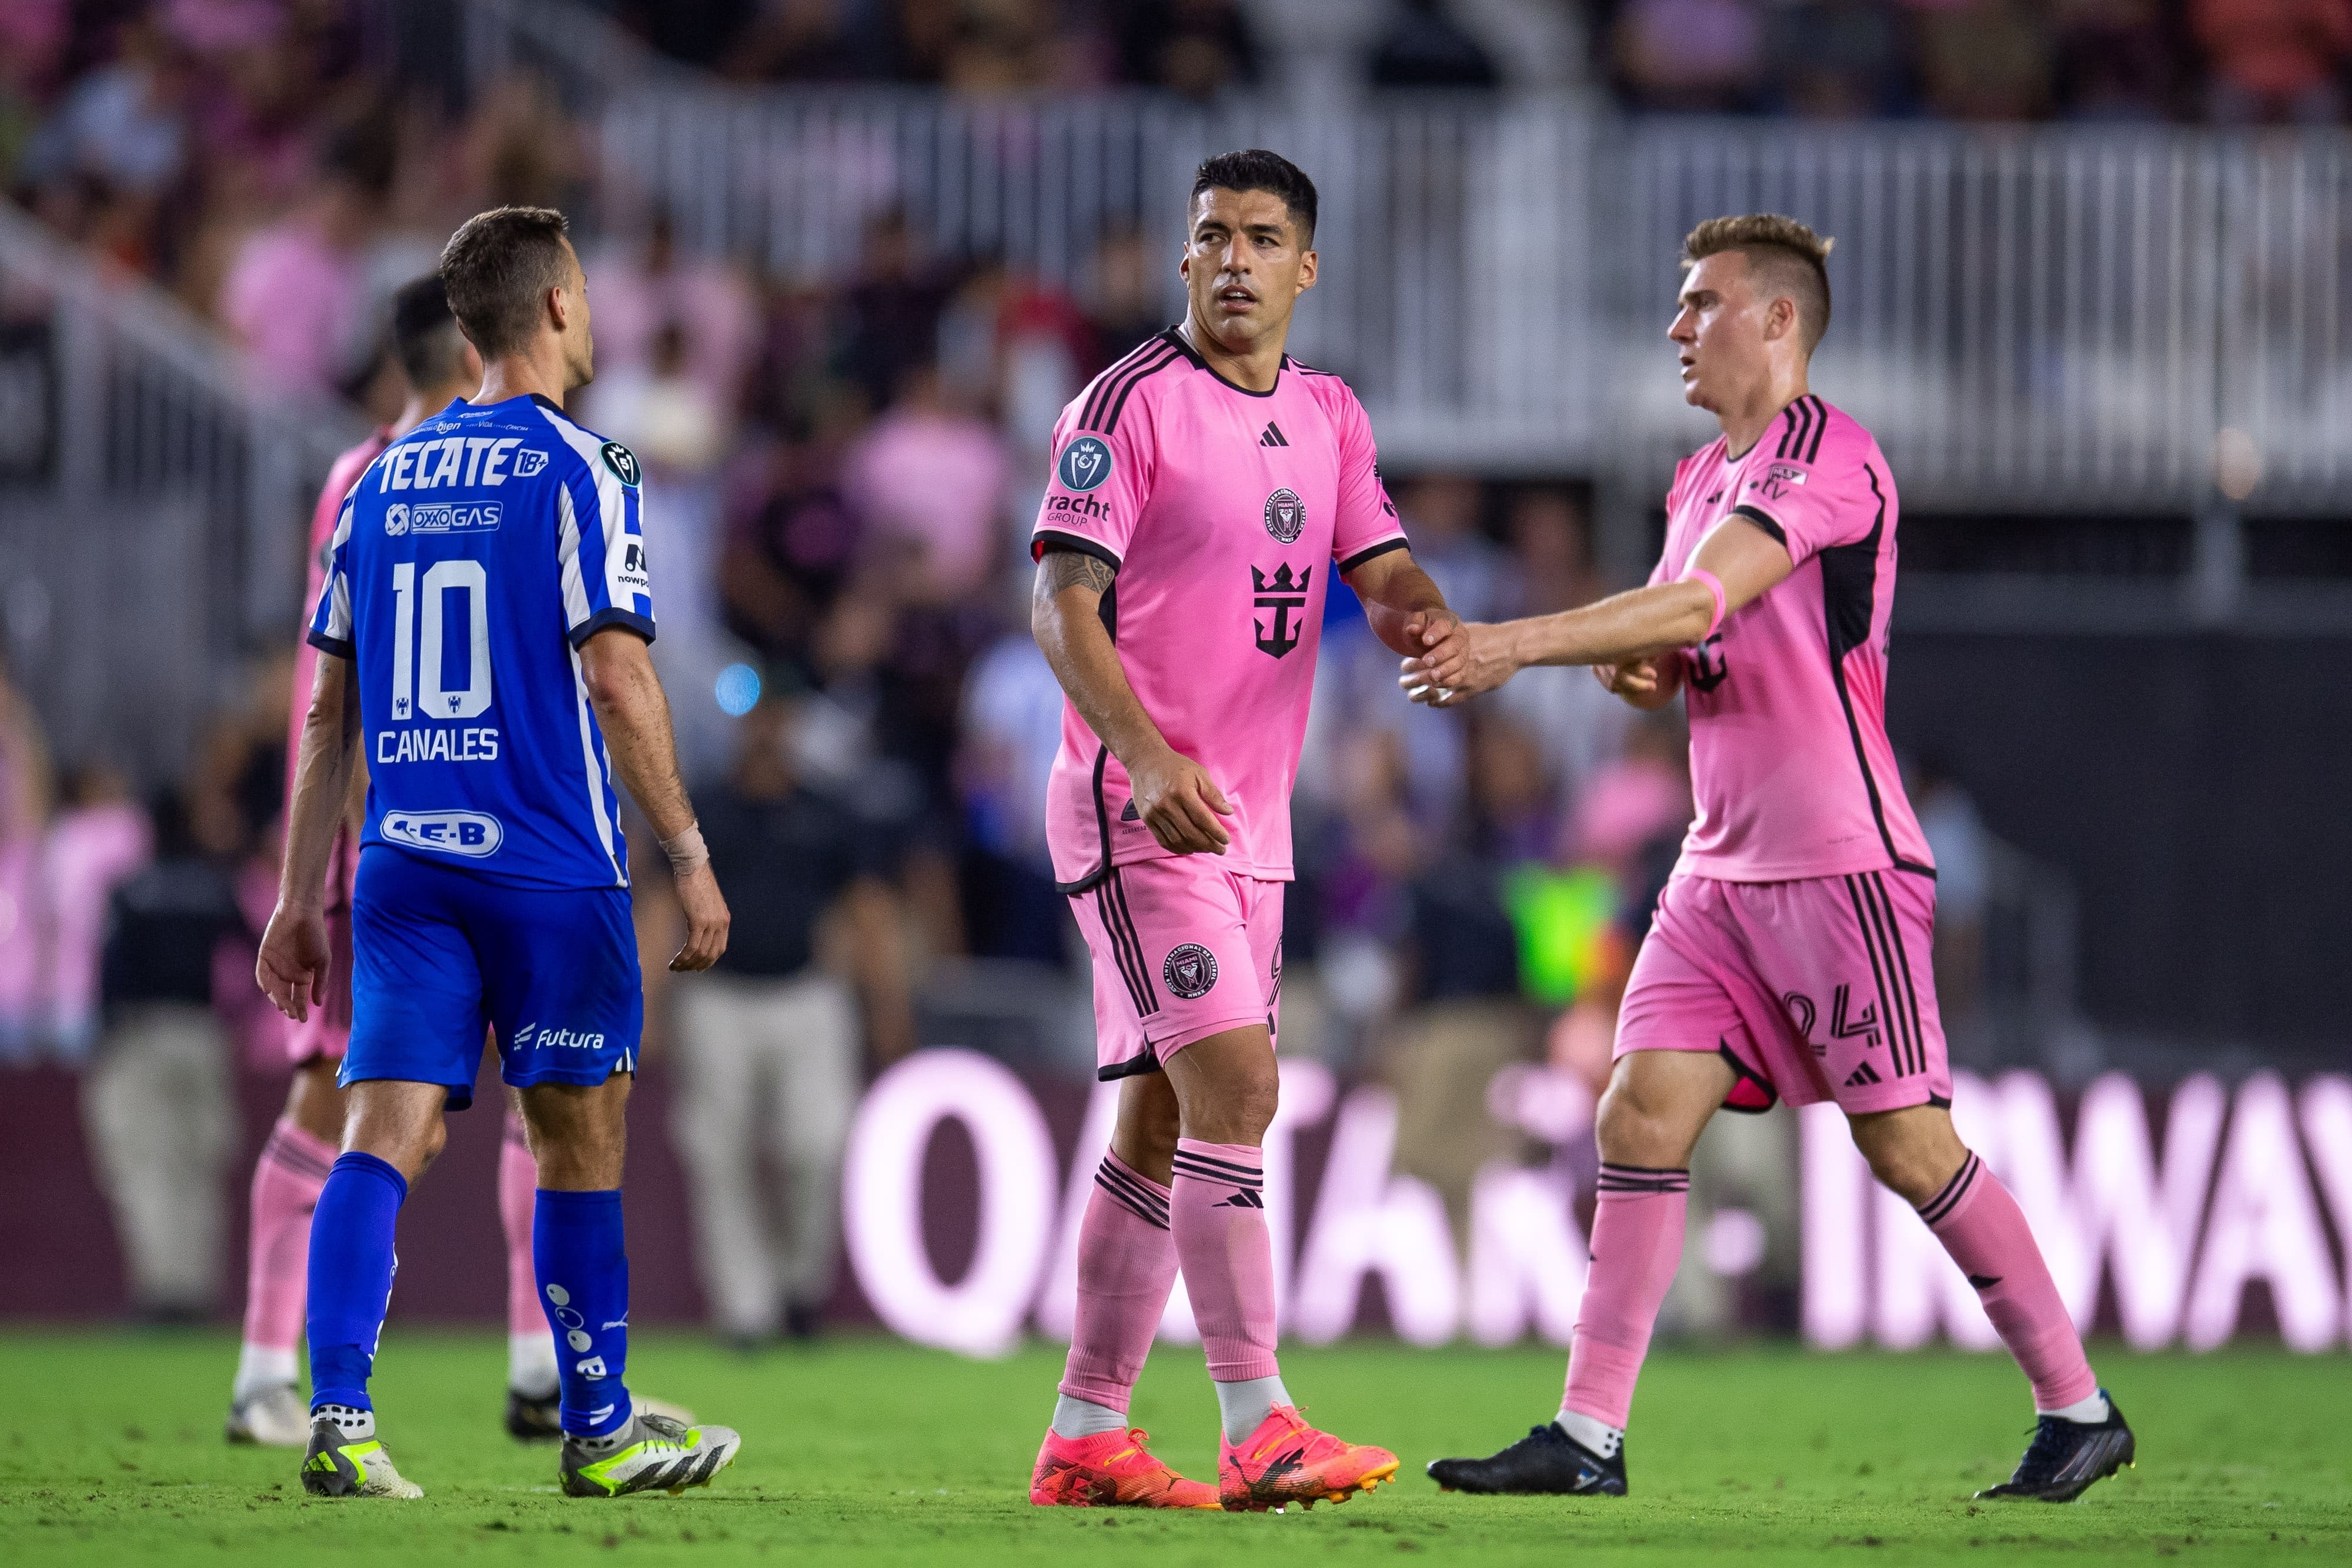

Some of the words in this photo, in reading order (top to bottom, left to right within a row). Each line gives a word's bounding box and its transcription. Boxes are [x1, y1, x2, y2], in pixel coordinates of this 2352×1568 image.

[378, 437, 524, 494] TECATE
[519, 452, 547, 474] 18+
[620, 457, 630, 470] 5
[1047, 493, 1110, 522] racht
[1047, 512, 1088, 527] GROUP
[392, 560, 492, 720] 10
[377, 728, 499, 763] CANALES
[1164, 945, 1201, 976] INTERNACIONAL
[1176, 955, 1198, 967] MIAMI
[1783, 983, 1882, 1057] 24
[535, 1028, 604, 1050] Futura
